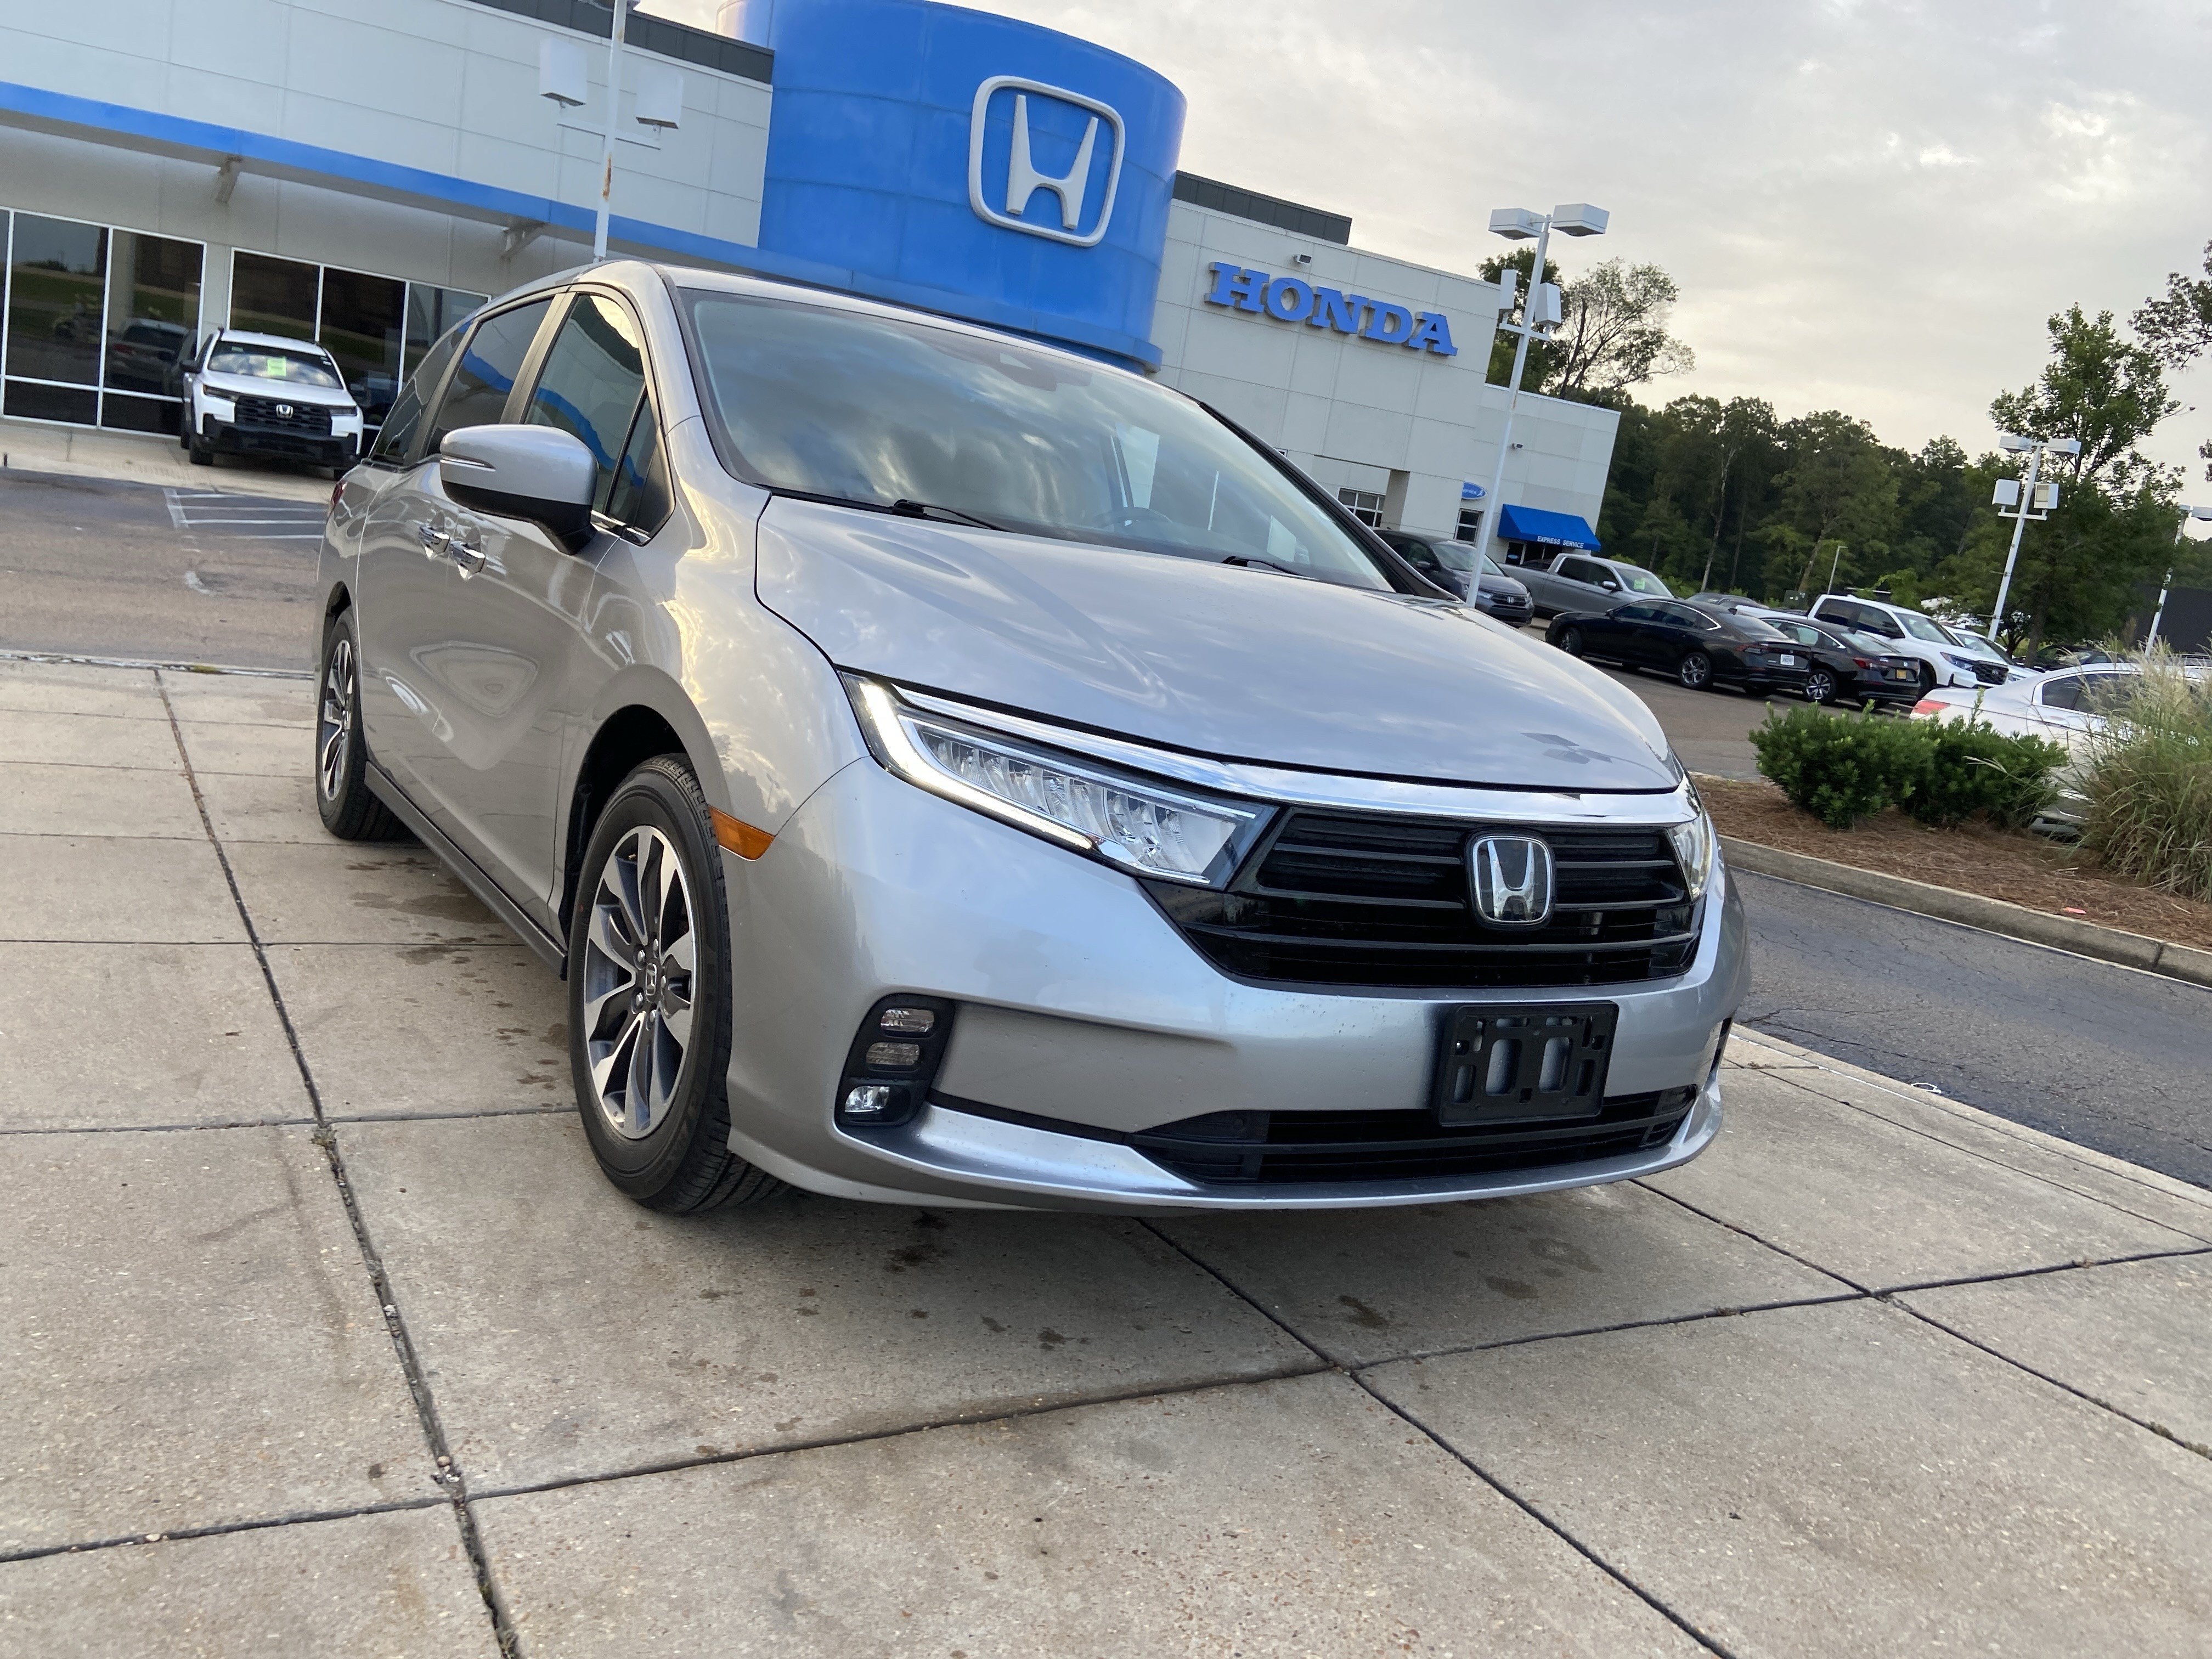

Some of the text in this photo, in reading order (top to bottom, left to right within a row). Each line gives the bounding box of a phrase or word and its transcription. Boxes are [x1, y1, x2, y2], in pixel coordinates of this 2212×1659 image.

[1204, 261, 1458, 357] HONDA
[1537, 535, 1584, 549] EXPRESS SERVICE
